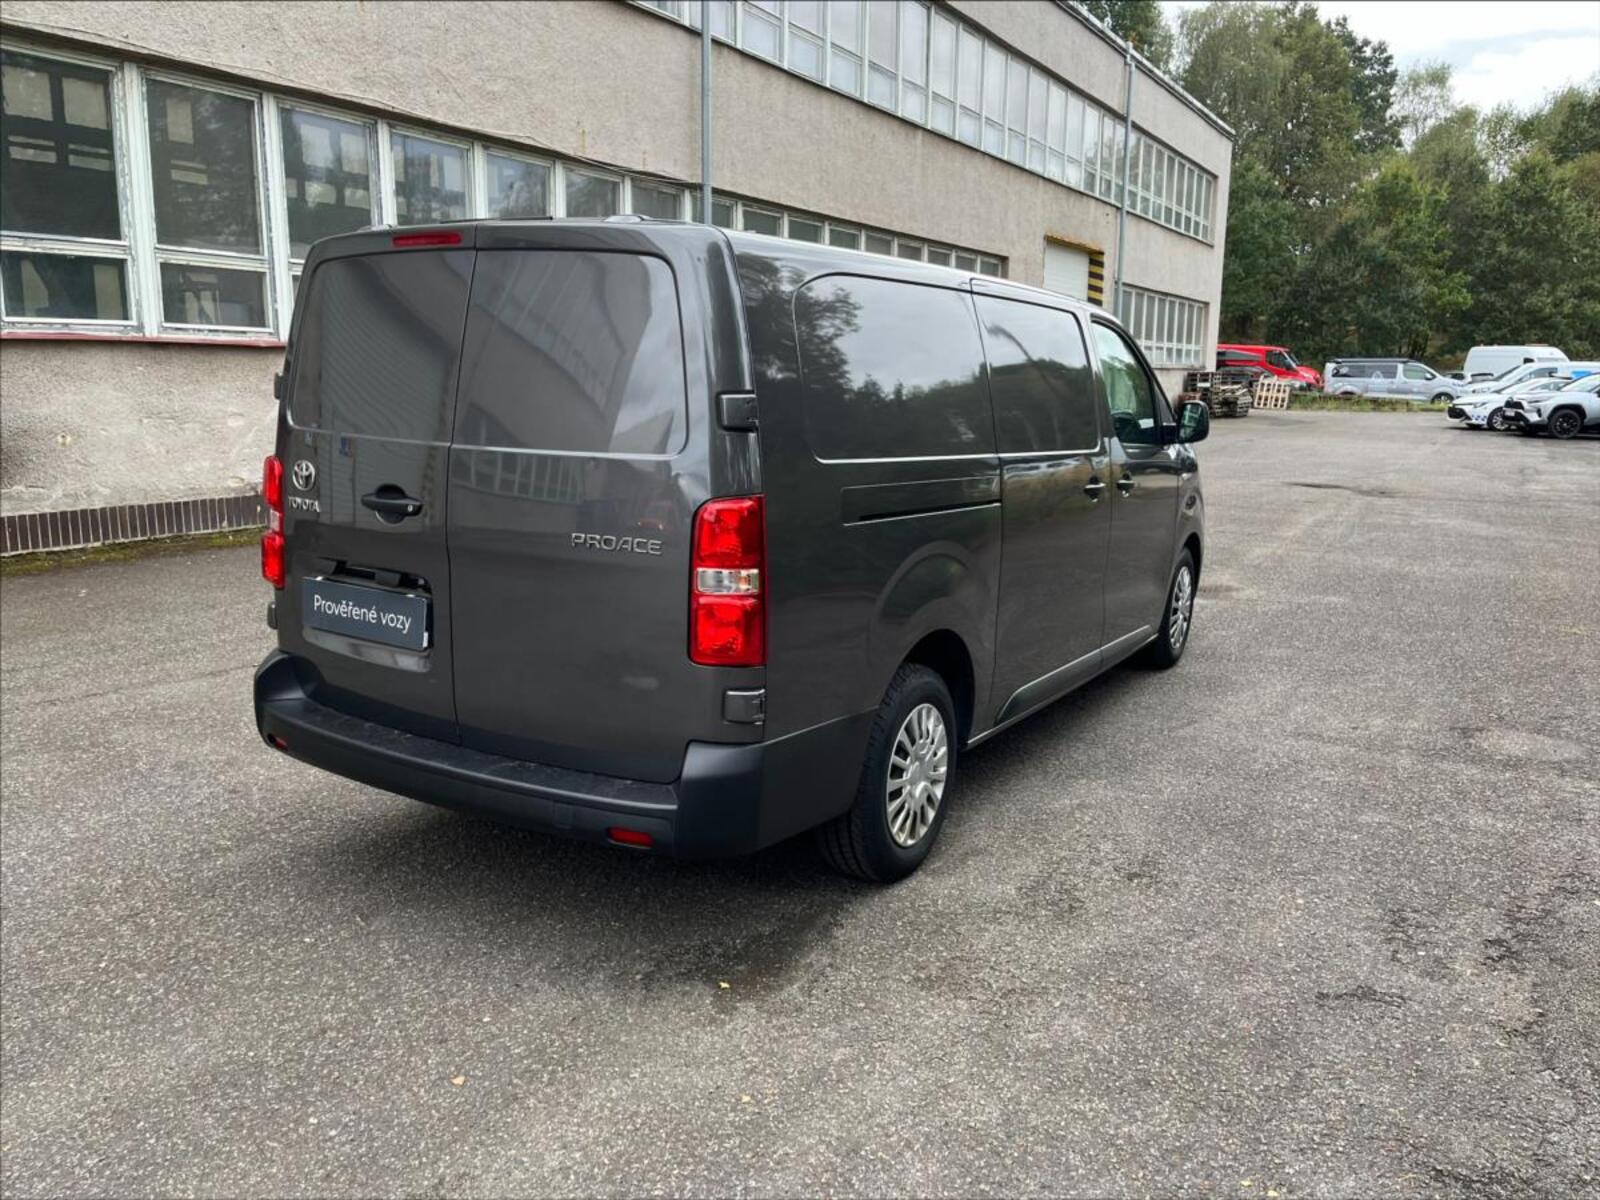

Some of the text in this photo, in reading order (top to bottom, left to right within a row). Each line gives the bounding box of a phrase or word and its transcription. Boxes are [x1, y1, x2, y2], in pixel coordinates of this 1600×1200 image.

[288, 496, 320, 512] TOYOTA
[571, 532, 662, 555] PROACE
[314, 594, 412, 634] Prověřené vozy
